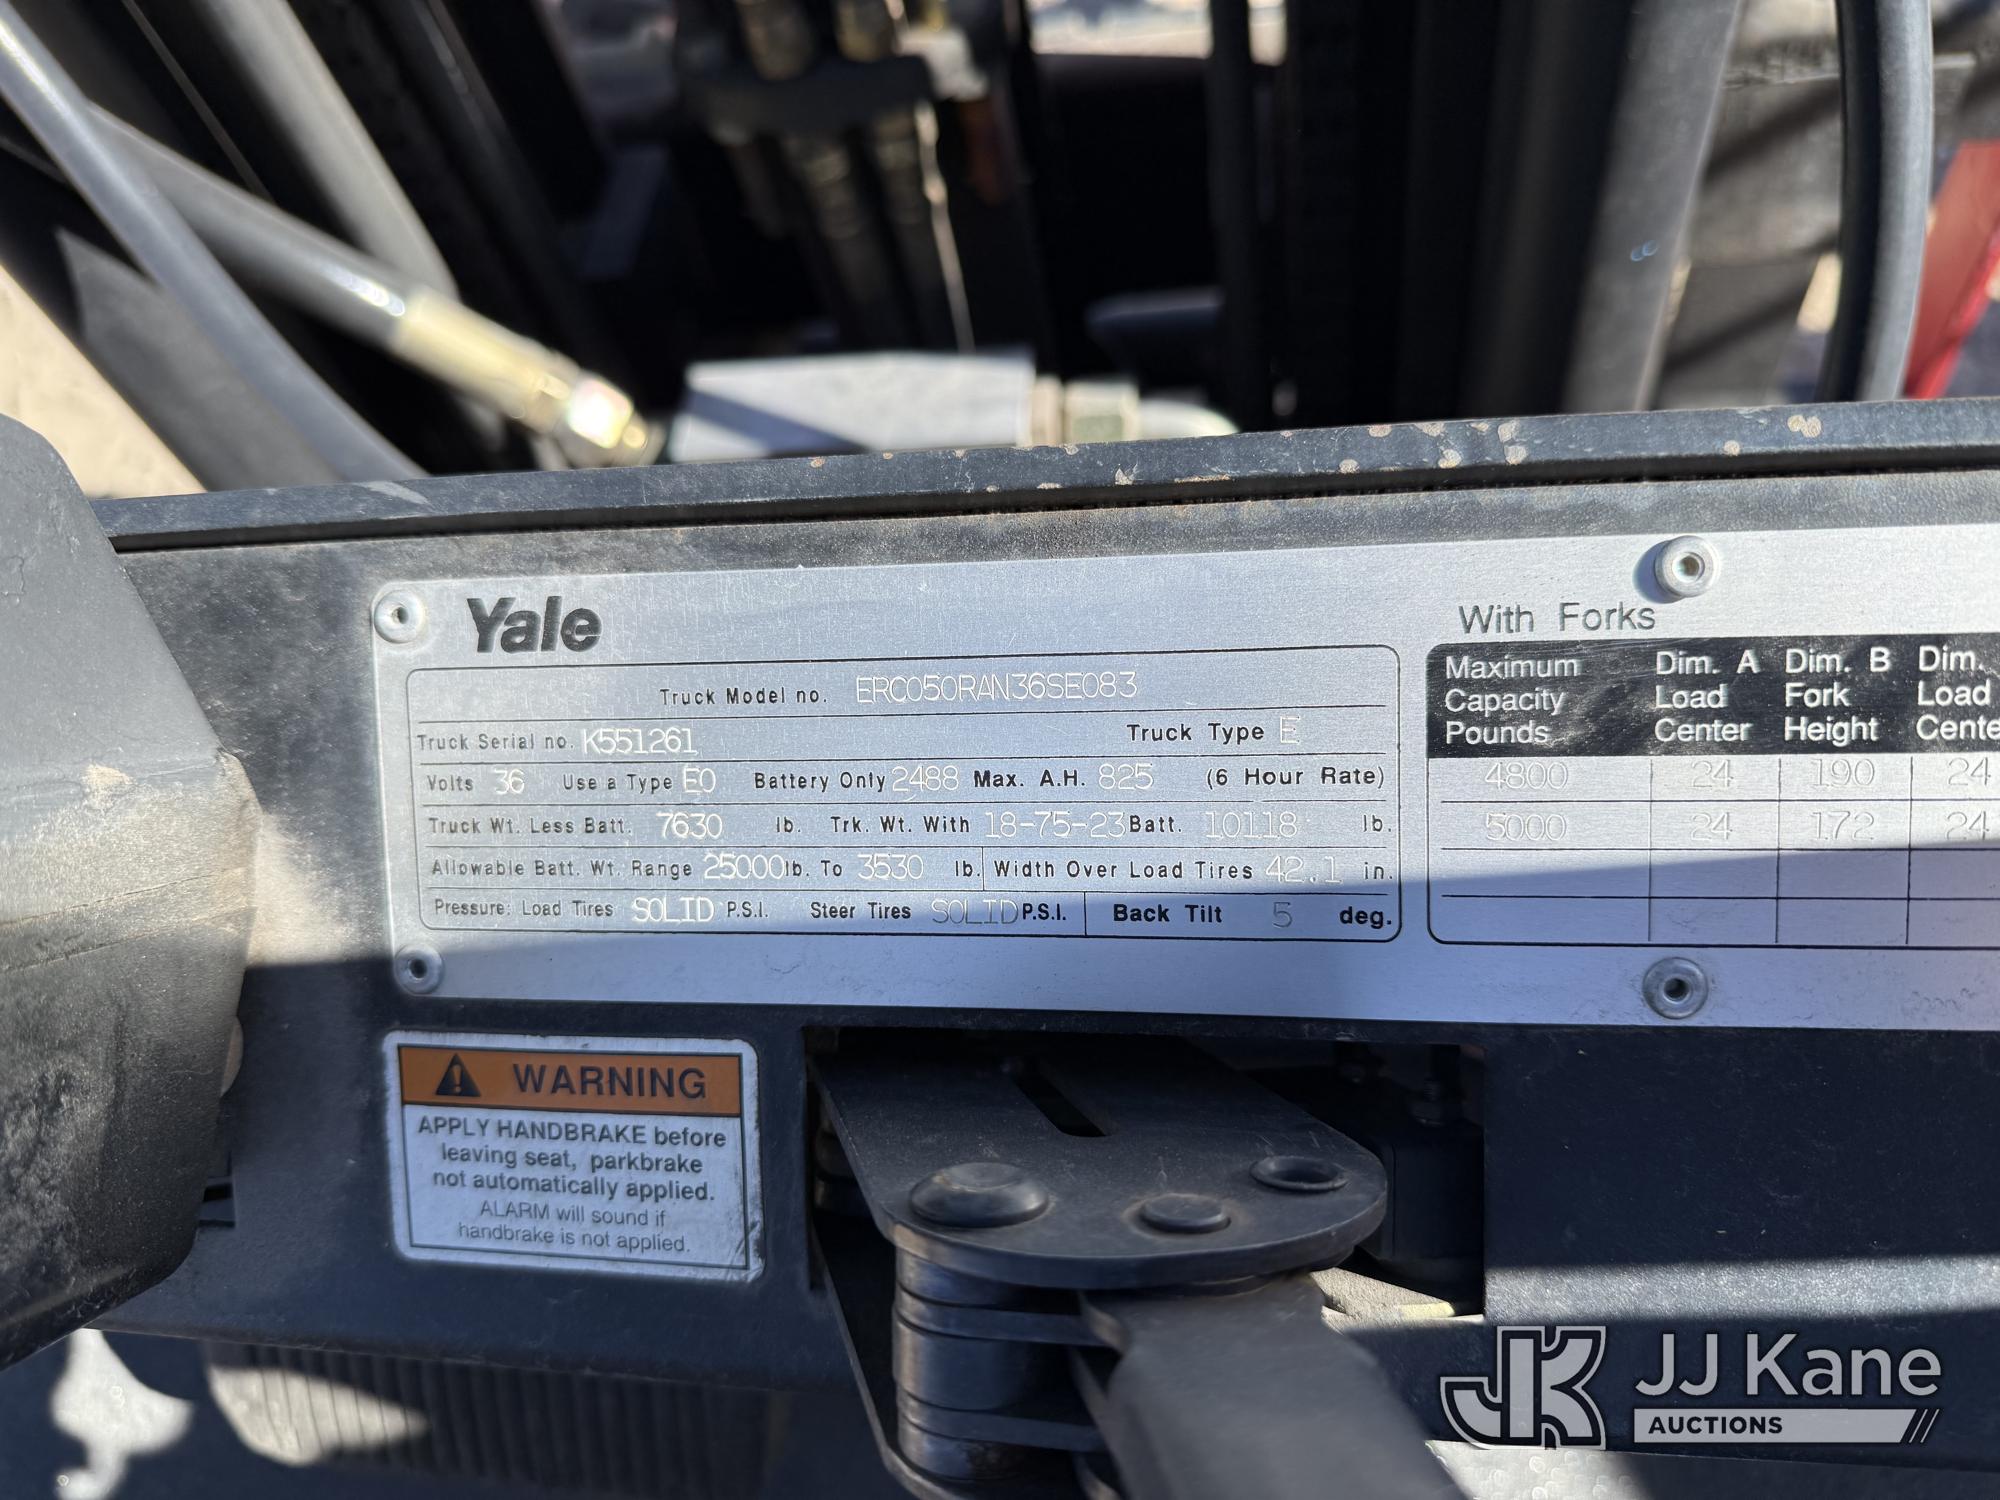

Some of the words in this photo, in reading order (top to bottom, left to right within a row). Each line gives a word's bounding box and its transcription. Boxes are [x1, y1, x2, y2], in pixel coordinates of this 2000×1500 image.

[466, 595, 602, 653] Yale
[1458, 603, 1535, 634] With
[1558, 601, 1656, 632] Forks
[1445, 654, 1580, 679] Maximum
[1656, 651, 1721, 675] Dim.
[1736, 649, 1761, 674] A
[1785, 648, 1850, 674] Dim.
[1869, 646, 1892, 673] B
[1917, 644, 1985, 672] Dim.
[660, 688, 715, 705] Truck
[726, 687, 786, 704] Model
[796, 690, 828, 703] no.
[1444, 686, 1567, 717] Capacity
[1655, 684, 1729, 709] Load
[1784, 681, 1851, 707] Fork
[1917, 678, 1992, 707] Load
[417, 734, 468, 750] Truck
[478, 733, 535, 750] Serial
[545, 736, 574, 750] no.
[582, 726, 698, 755] K551261
[1127, 723, 1192, 741] Truck
[1207, 722, 1265, 745] Type
[1280, 716, 1300, 744] E
[1445, 717, 1550, 745] Pounds
[1654, 717, 1753, 742] Center
[1783, 715, 1879, 747] Height
[427, 774, 474, 791] Volts
[494, 768, 525, 794] 36
[562, 774, 597, 790] Use
[607, 778, 617, 790] a
[626, 773, 673, 794] Type
[754, 771, 829, 792] Battery
[840, 771, 886, 792] Only
[891, 764, 959, 791] 2488
[974, 769, 1024, 788] Max.
[1040, 769, 1086, 787] A.H.
[1099, 763, 1154, 790] 825
[1206, 767, 1228, 790] (6
[1245, 767, 1304, 785] Hour
[1321, 766, 1385, 789] Rate)
[1484, 762, 1569, 790] 4800
[1691, 759, 1734, 788] 24
[1811, 758, 1875, 788] 190
[1948, 757, 1992, 787] 24
[428, 817, 481, 834] Truck
[490, 817, 520, 834] Wt.
[530, 817, 574, 834] Less
[584, 817, 632, 834] Batt.
[656, 811, 723, 839] 7630
[776, 816, 801, 833] lb.
[831, 816, 869, 833] Trk.
[880, 815, 913, 833] Wt.
[924, 815, 970, 833] With
[985, 811, 1126, 839] 18-75-23
[1129, 815, 1182, 833] Batt.
[1205, 811, 1298, 839] 10118
[1363, 814, 1392, 832] lb.
[1485, 813, 1567, 841] 5000
[1690, 811, 1733, 841] 24
[1811, 810, 1875, 841] 172
[1946, 810, 1990, 841] 24
[431, 859, 525, 876] Allowable
[534, 859, 580, 876] Batt.
[590, 859, 621, 876] Wt.
[631, 859, 693, 880] Range
[820, 860, 843, 877] To
[857, 853, 924, 881] 3530
[955, 860, 981, 877] lb.
[994, 860, 1055, 877] Width
[1067, 860, 1117, 878] Over
[1130, 861, 1183, 878] Load
[1195, 861, 1253, 879] Tires
[1265, 855, 1343, 883] 42.1
[1364, 861, 1394, 880] in.
[435, 898, 511, 916] Pressure:
[522, 900, 561, 916] Load
[572, 900, 614, 916] Tires
[631, 896, 715, 923] SOLID
[727, 901, 769, 918] P.S.I.
[810, 901, 856, 919] Steer
[867, 902, 912, 919] Tires
[931, 899, 1018, 925] SOLID
[1022, 902, 1067, 921] P.S.I.
[1113, 904, 1170, 922] Back
[1184, 904, 1223, 923] Tilt
[1272, 901, 1293, 928] 5
[1339, 905, 1393, 930] deg.
[512, 1063, 707, 1099] WARNING
[418, 1115, 491, 1136] APPLY
[498, 1120, 647, 1144] HANDBRAKE
[654, 1125, 727, 1148] before
[442, 1142, 517, 1169] leaving
[525, 1148, 577, 1172] seat,
[590, 1151, 703, 1175] parkbrake
[433, 1170, 466, 1189] not
[473, 1174, 619, 1202] automatically
[625, 1181, 716, 1203] applied.
[480, 1199, 550, 1221] ALARM
[556, 1205, 585, 1223] will
[592, 1208, 649, 1227] sound
[655, 1209, 667, 1228] if
[458, 1221, 555, 1245] handbrake
[560, 1226, 575, 1245] is
[580, 1229, 611, 1248] not
[616, 1231, 691, 1255] applied.
